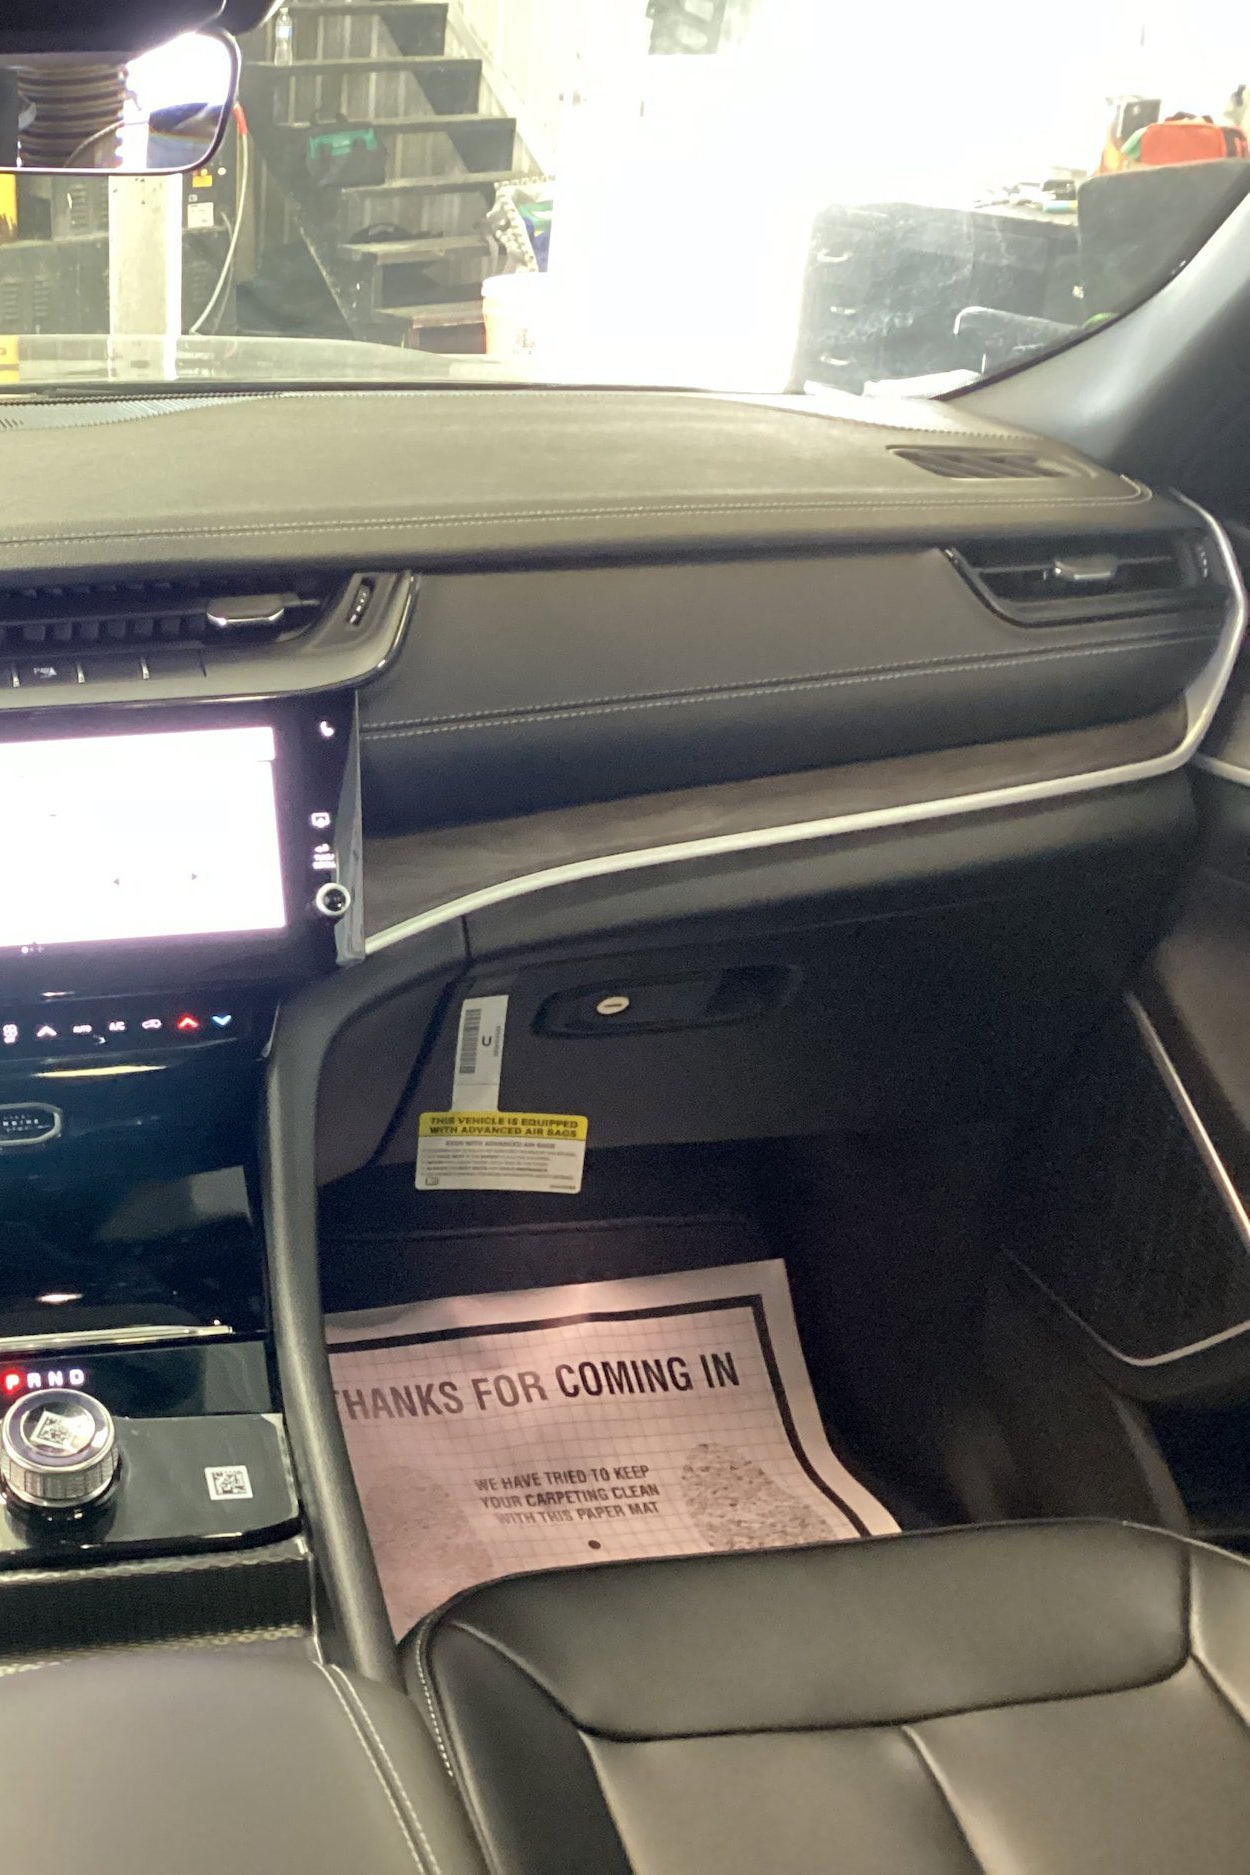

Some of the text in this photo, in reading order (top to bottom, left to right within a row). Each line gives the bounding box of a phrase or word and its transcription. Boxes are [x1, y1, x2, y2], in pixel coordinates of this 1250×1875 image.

[73, 1024, 92, 1033] AUTO
[109, 1021, 126, 1031] A/C
[430, 1117, 578, 1129] THIS VEHICLE IS EQUIPPED
[430, 1126, 577, 1138] WITH ADVANCED AIR BAGS
[6, 1368, 85, 1390] P R N D
[335, 1352, 740, 1421] HANKS FOR COMING IN
[474, 1465, 649, 1491] WE HAVE TRIED TO KEEP
[480, 1484, 660, 1509] YOUR CARPETING CLEAN
[495, 1501, 659, 1525] WITH THIS PAPER MAT
